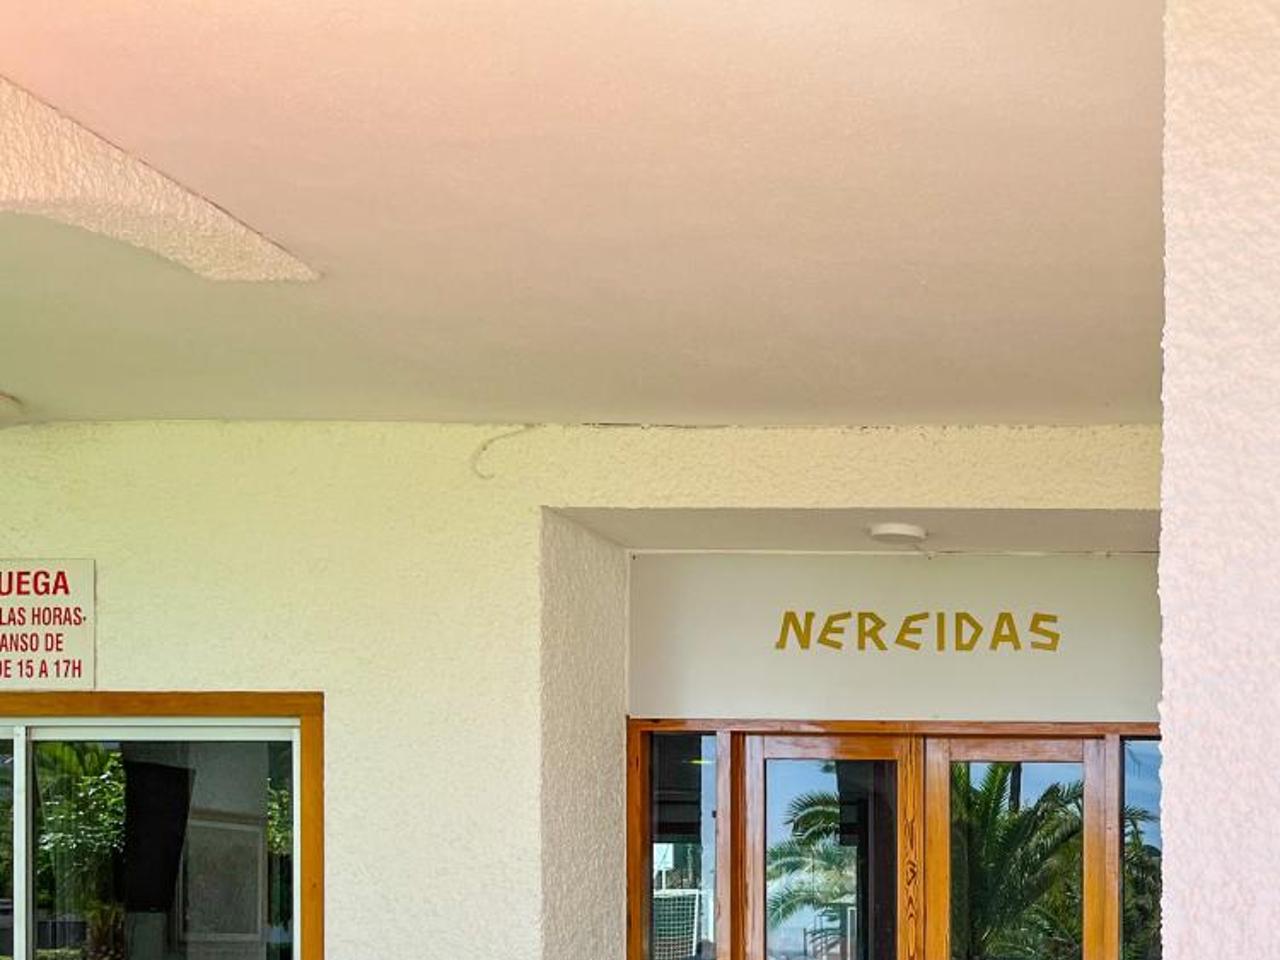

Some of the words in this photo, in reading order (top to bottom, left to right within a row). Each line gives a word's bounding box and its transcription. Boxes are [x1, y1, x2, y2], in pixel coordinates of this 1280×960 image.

[0, 571, 69, 595] UEGA
[0, 607, 26, 626] LAS
[31, 607, 82, 626] HORAS
[775, 611, 1061, 651] NEREIDAS
[0, 633, 39, 652] ANSO
[45, 633, 63, 651] DE
[0, 659, 11, 678] E
[17, 659, 34, 678] 15
[39, 659, 48, 678] A
[54, 659, 82, 678] 17H
